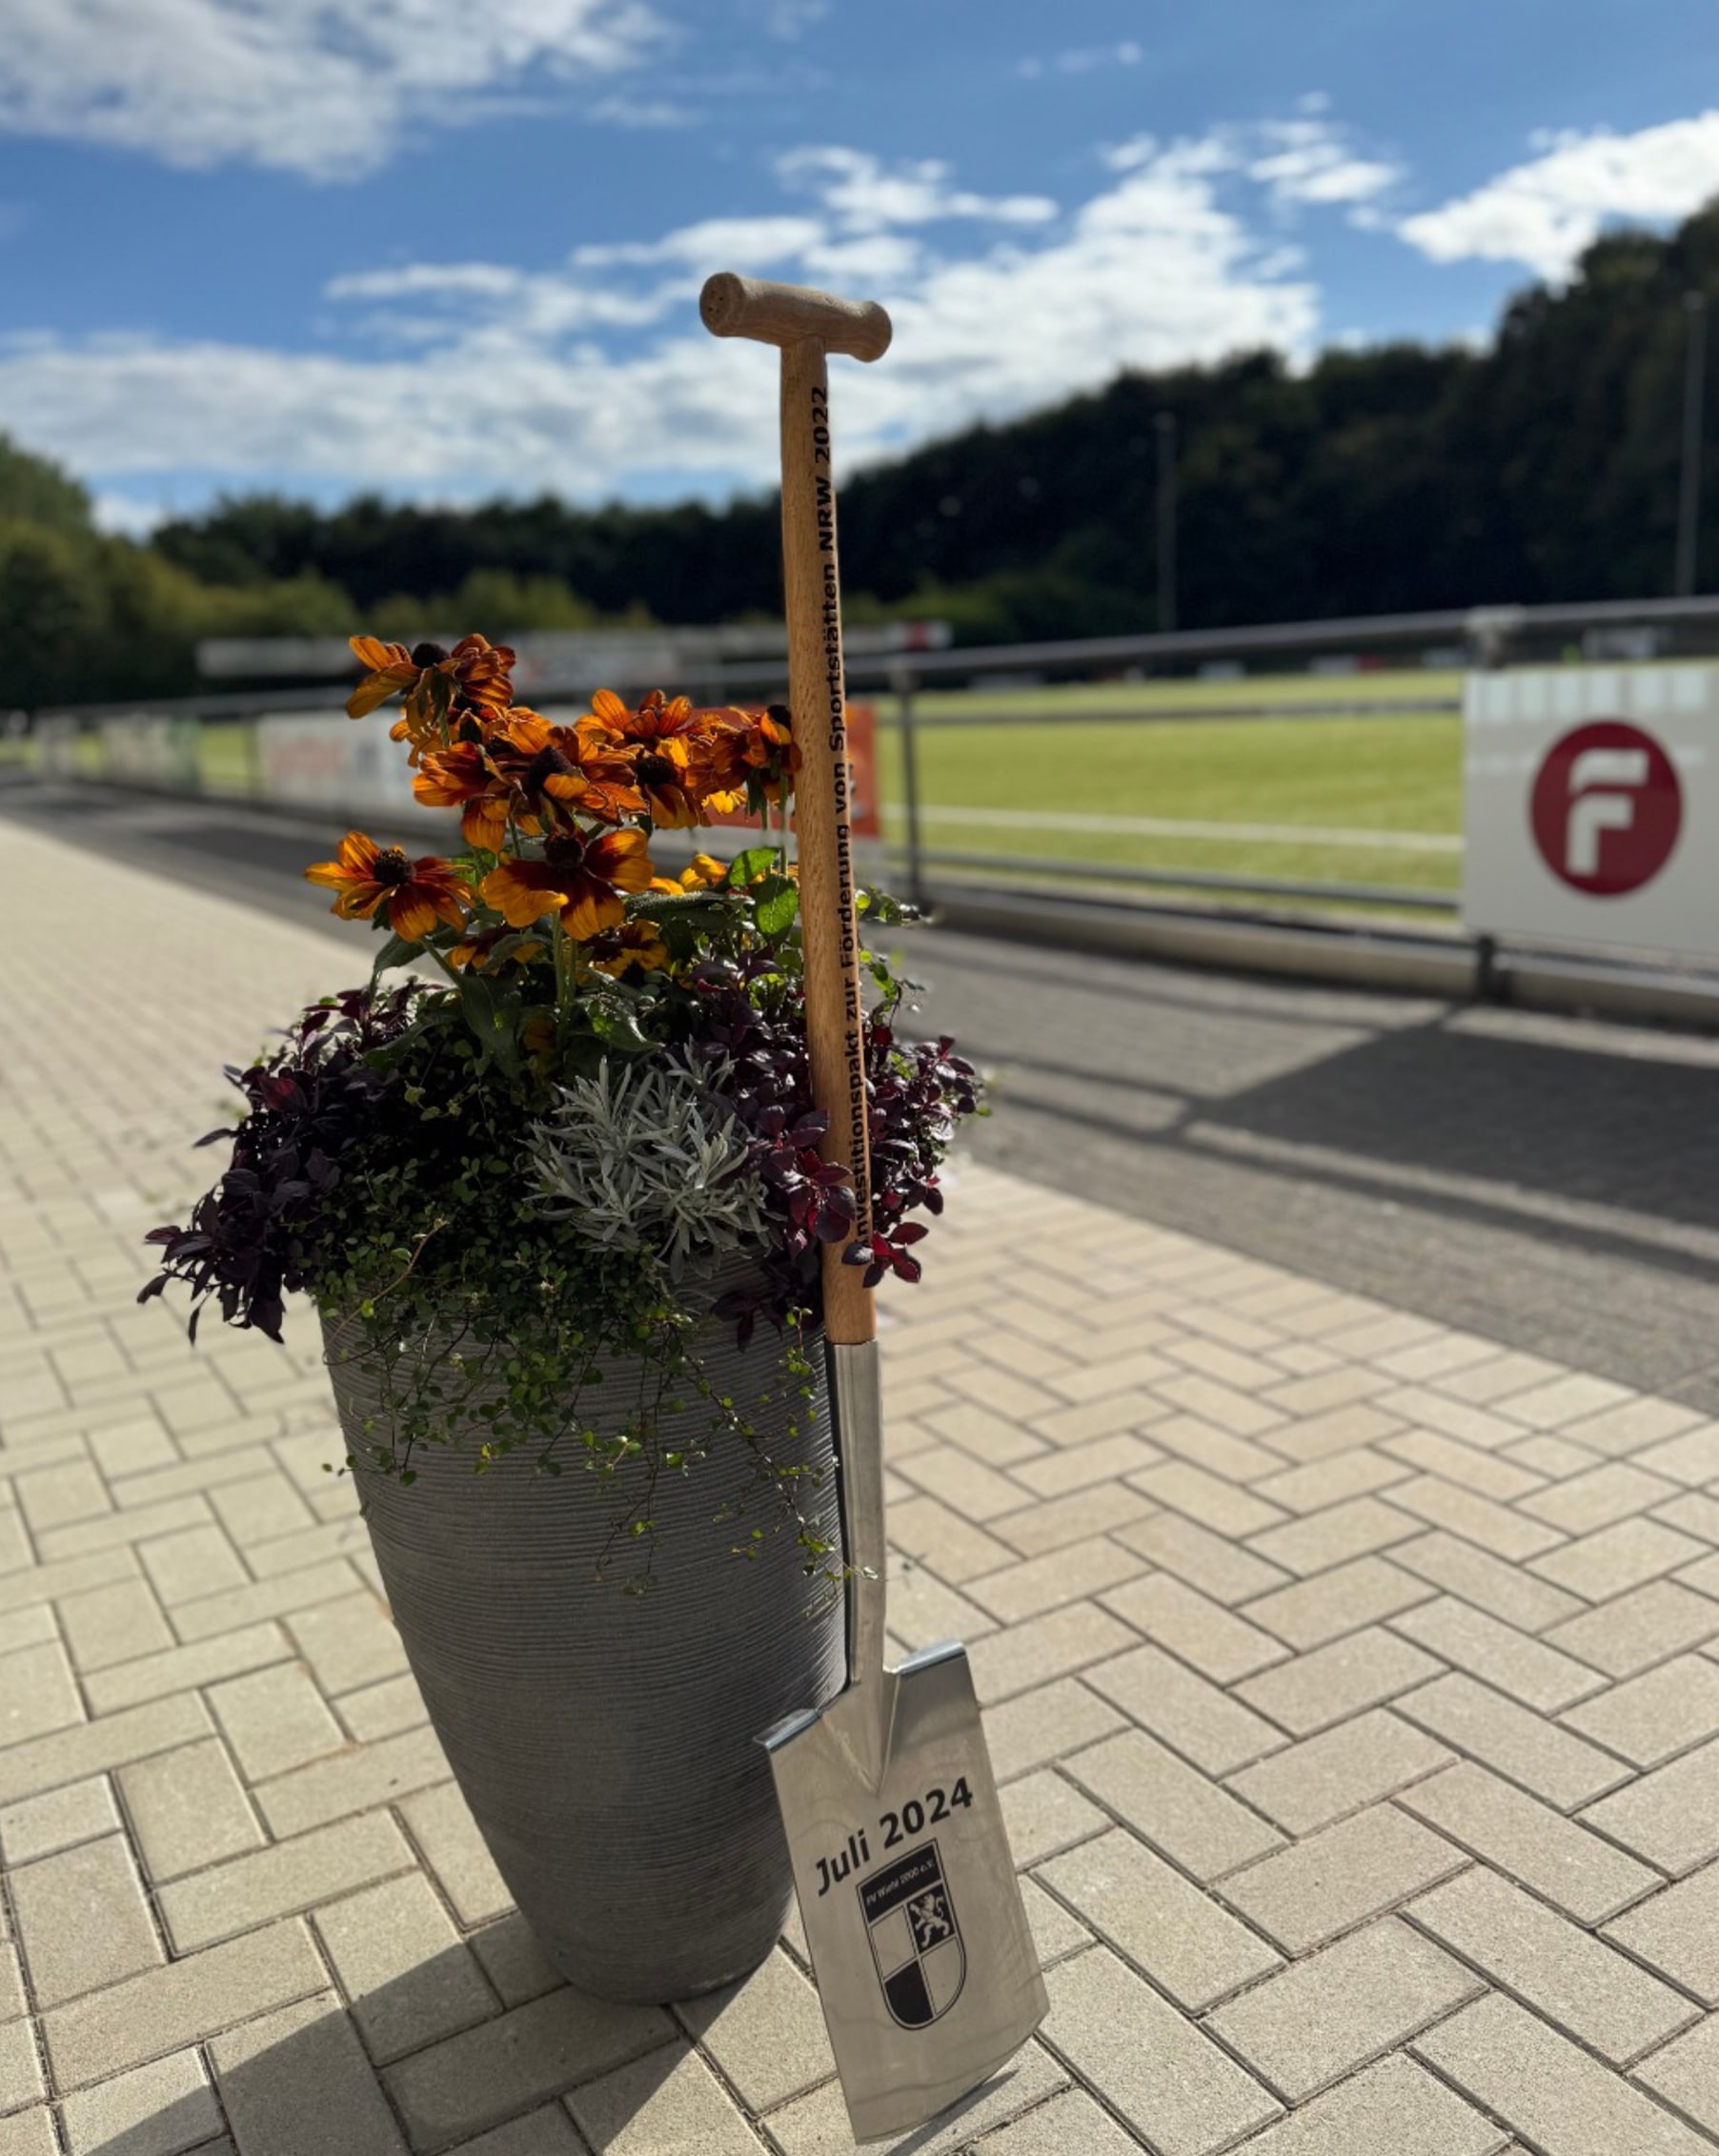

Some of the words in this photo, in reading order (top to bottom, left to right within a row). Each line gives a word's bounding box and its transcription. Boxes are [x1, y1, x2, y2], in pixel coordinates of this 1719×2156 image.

[812, 386, 830, 463] 2022
[815, 477, 834, 552] NRW
[822, 563, 845, 752] Sportstätten
[834, 763, 847, 814] von
[837, 824, 854, 968] Förderung
[843, 977, 859, 1021] zur
[816, 1827, 871, 1897] Juli
[879, 1776, 973, 1850] 2024
